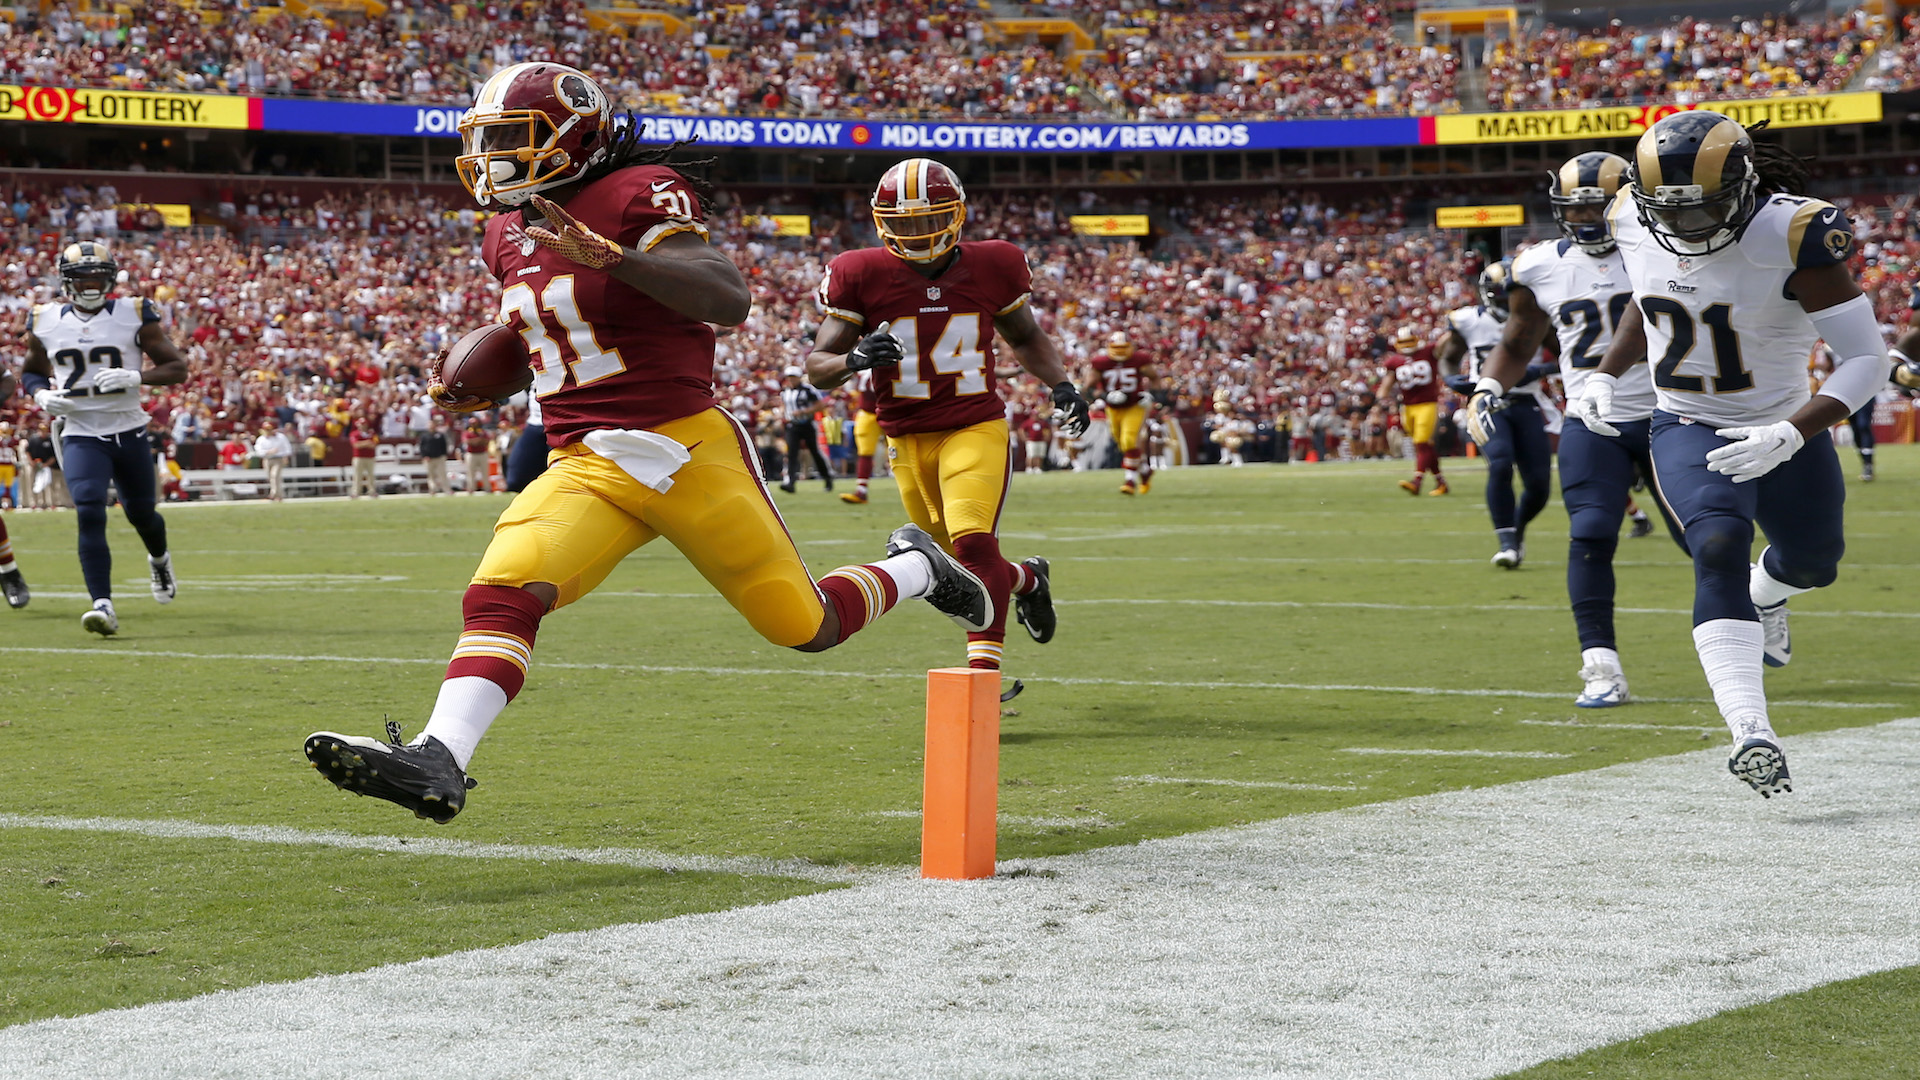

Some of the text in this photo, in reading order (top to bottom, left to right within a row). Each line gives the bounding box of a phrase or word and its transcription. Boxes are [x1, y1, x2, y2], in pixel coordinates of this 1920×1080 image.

[86, 95, 203, 122] LOTTERY
[1478, 101, 1830, 137] MARYLAND OTTERY
[642, 117, 755, 141] REWARDS
[760, 121, 842, 144] TODAY
[881, 125, 1250, 148] MDLOTTERY.COM/REWARDS
[500, 273, 628, 398] 31
[1640, 294, 1756, 395] 21
[888, 312, 989, 400] 14
[1103, 367, 1137, 393] 75
